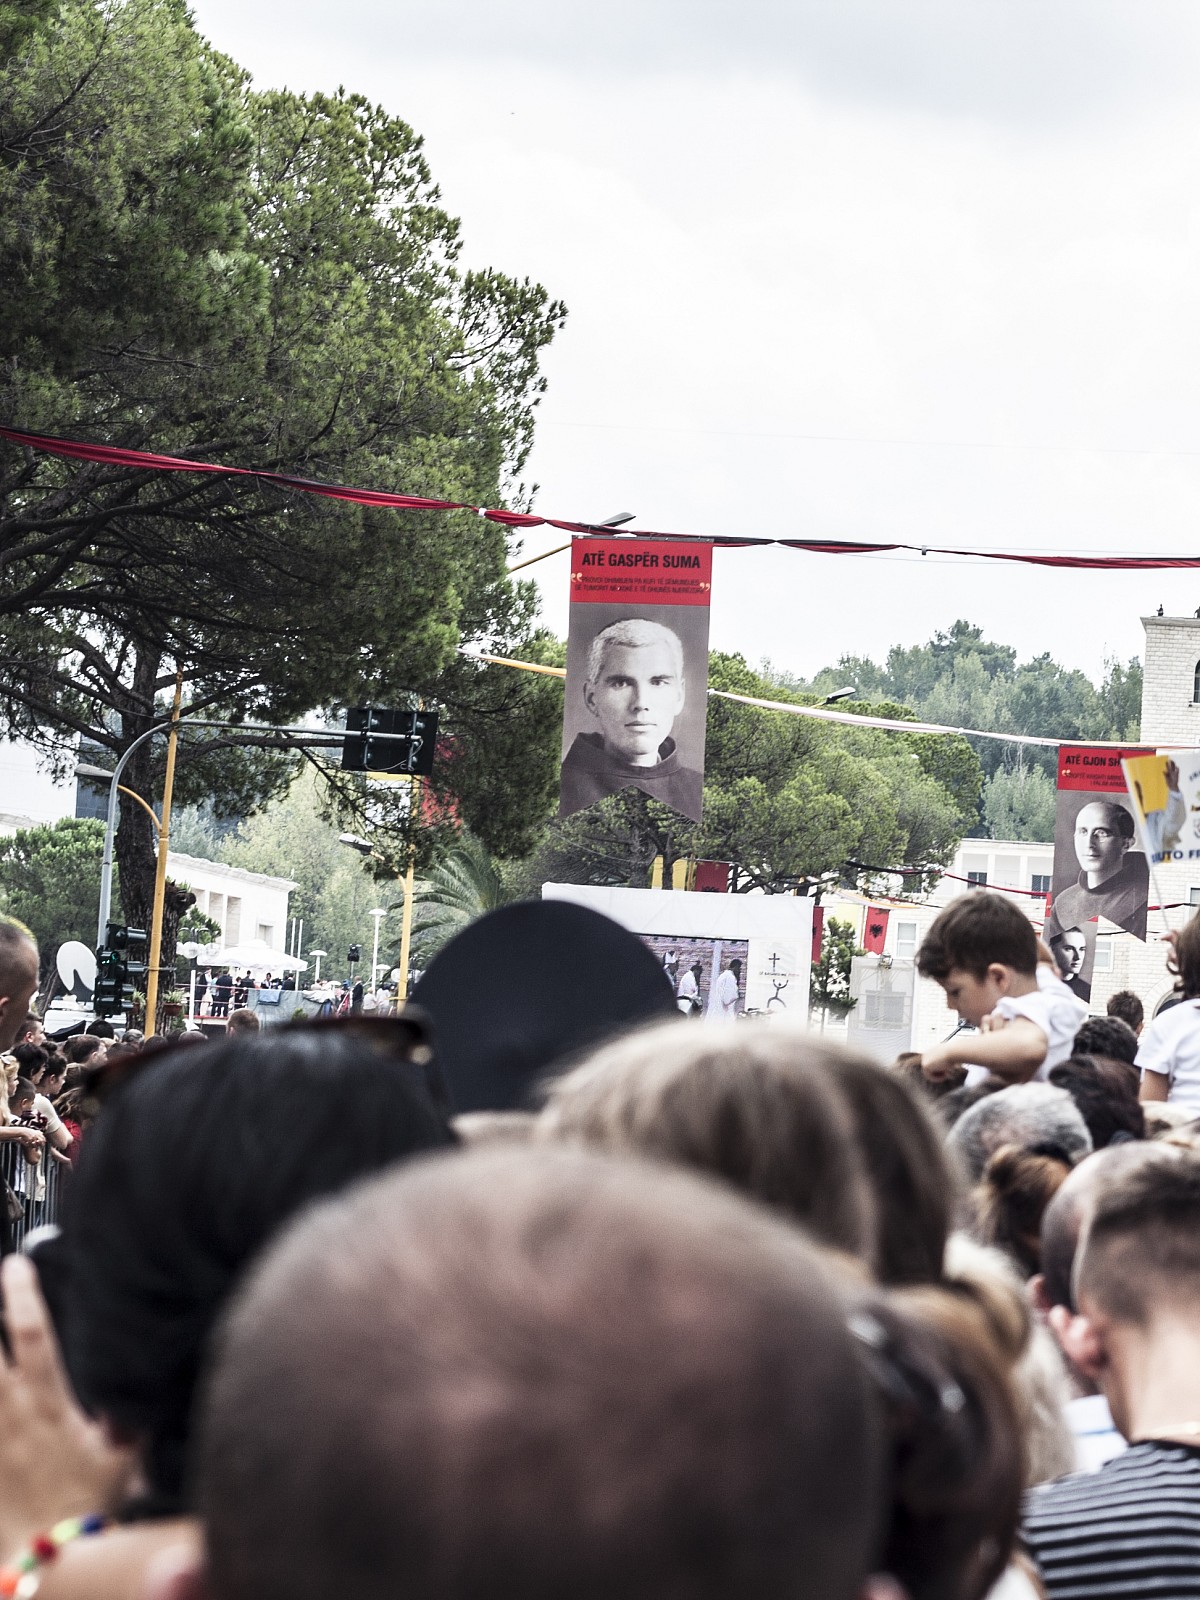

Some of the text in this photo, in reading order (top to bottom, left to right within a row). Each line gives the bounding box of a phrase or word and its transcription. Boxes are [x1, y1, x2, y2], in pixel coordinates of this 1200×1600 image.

[582, 550, 701, 569] ATË GASPËR SUMA
[1065, 753, 1121, 767] ATË GJON SH
